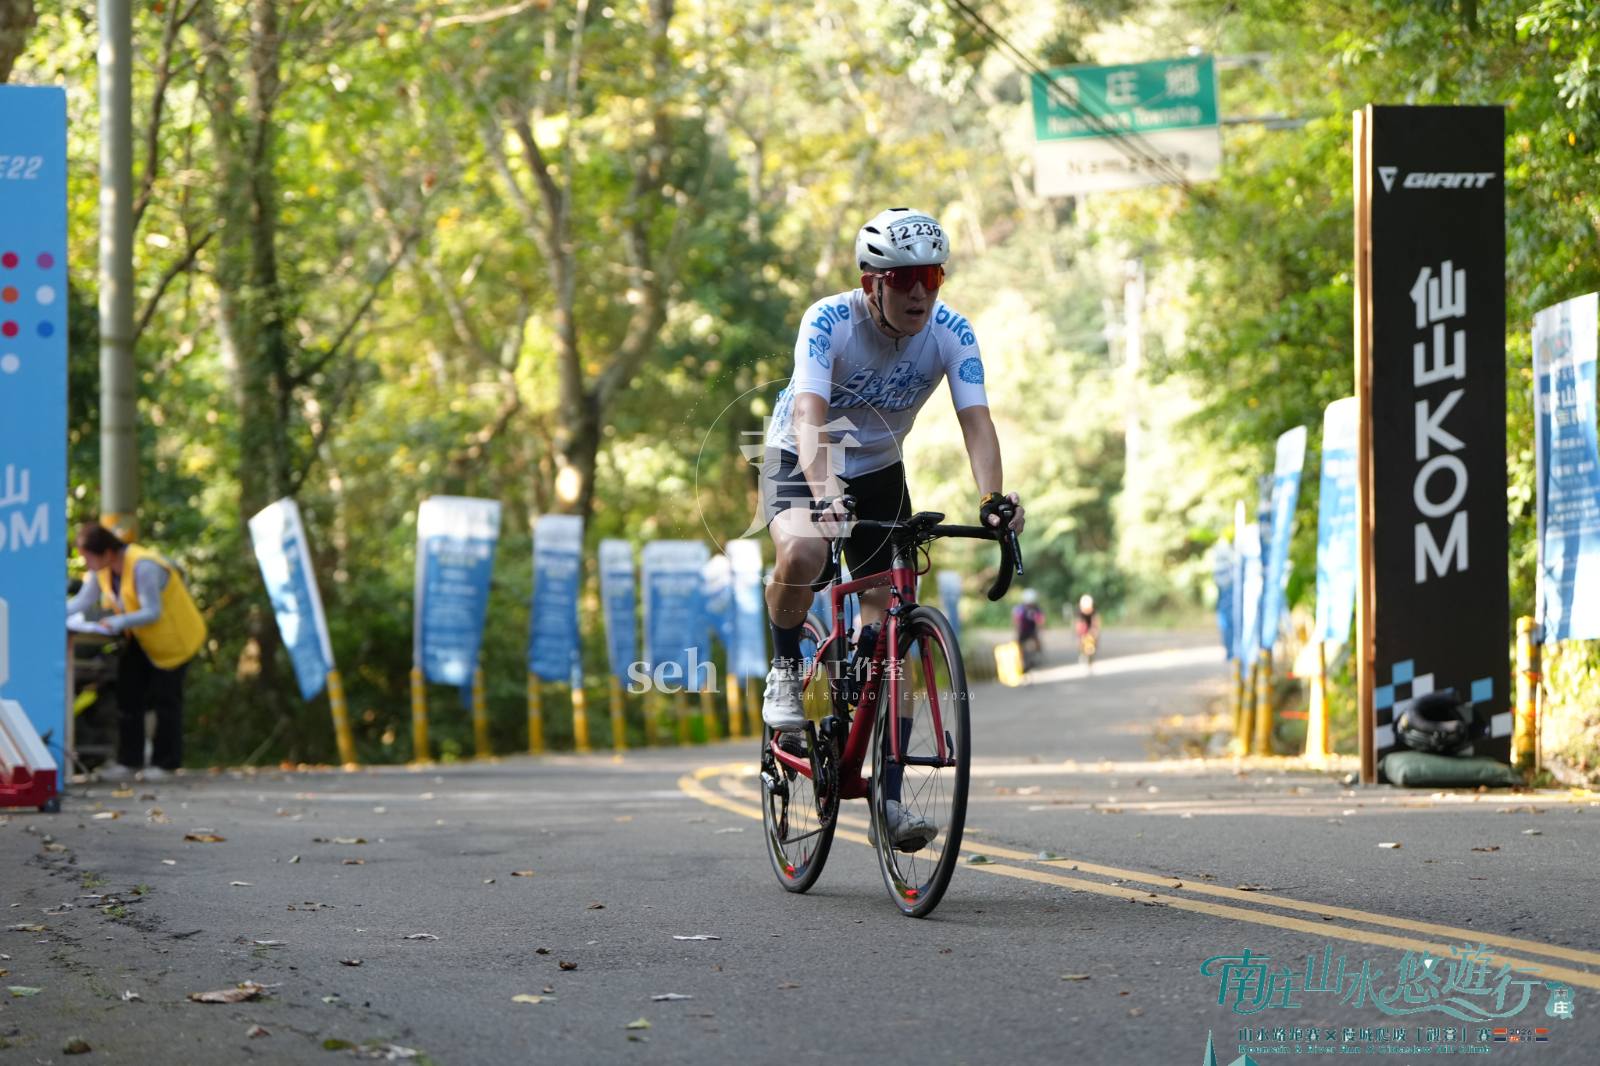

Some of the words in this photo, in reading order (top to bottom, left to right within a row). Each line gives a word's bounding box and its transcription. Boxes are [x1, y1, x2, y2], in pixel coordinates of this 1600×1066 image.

[1403, 172, 1496, 189] GIANT
[935, 304, 975, 346] bike
[0, 502, 49, 553] M
